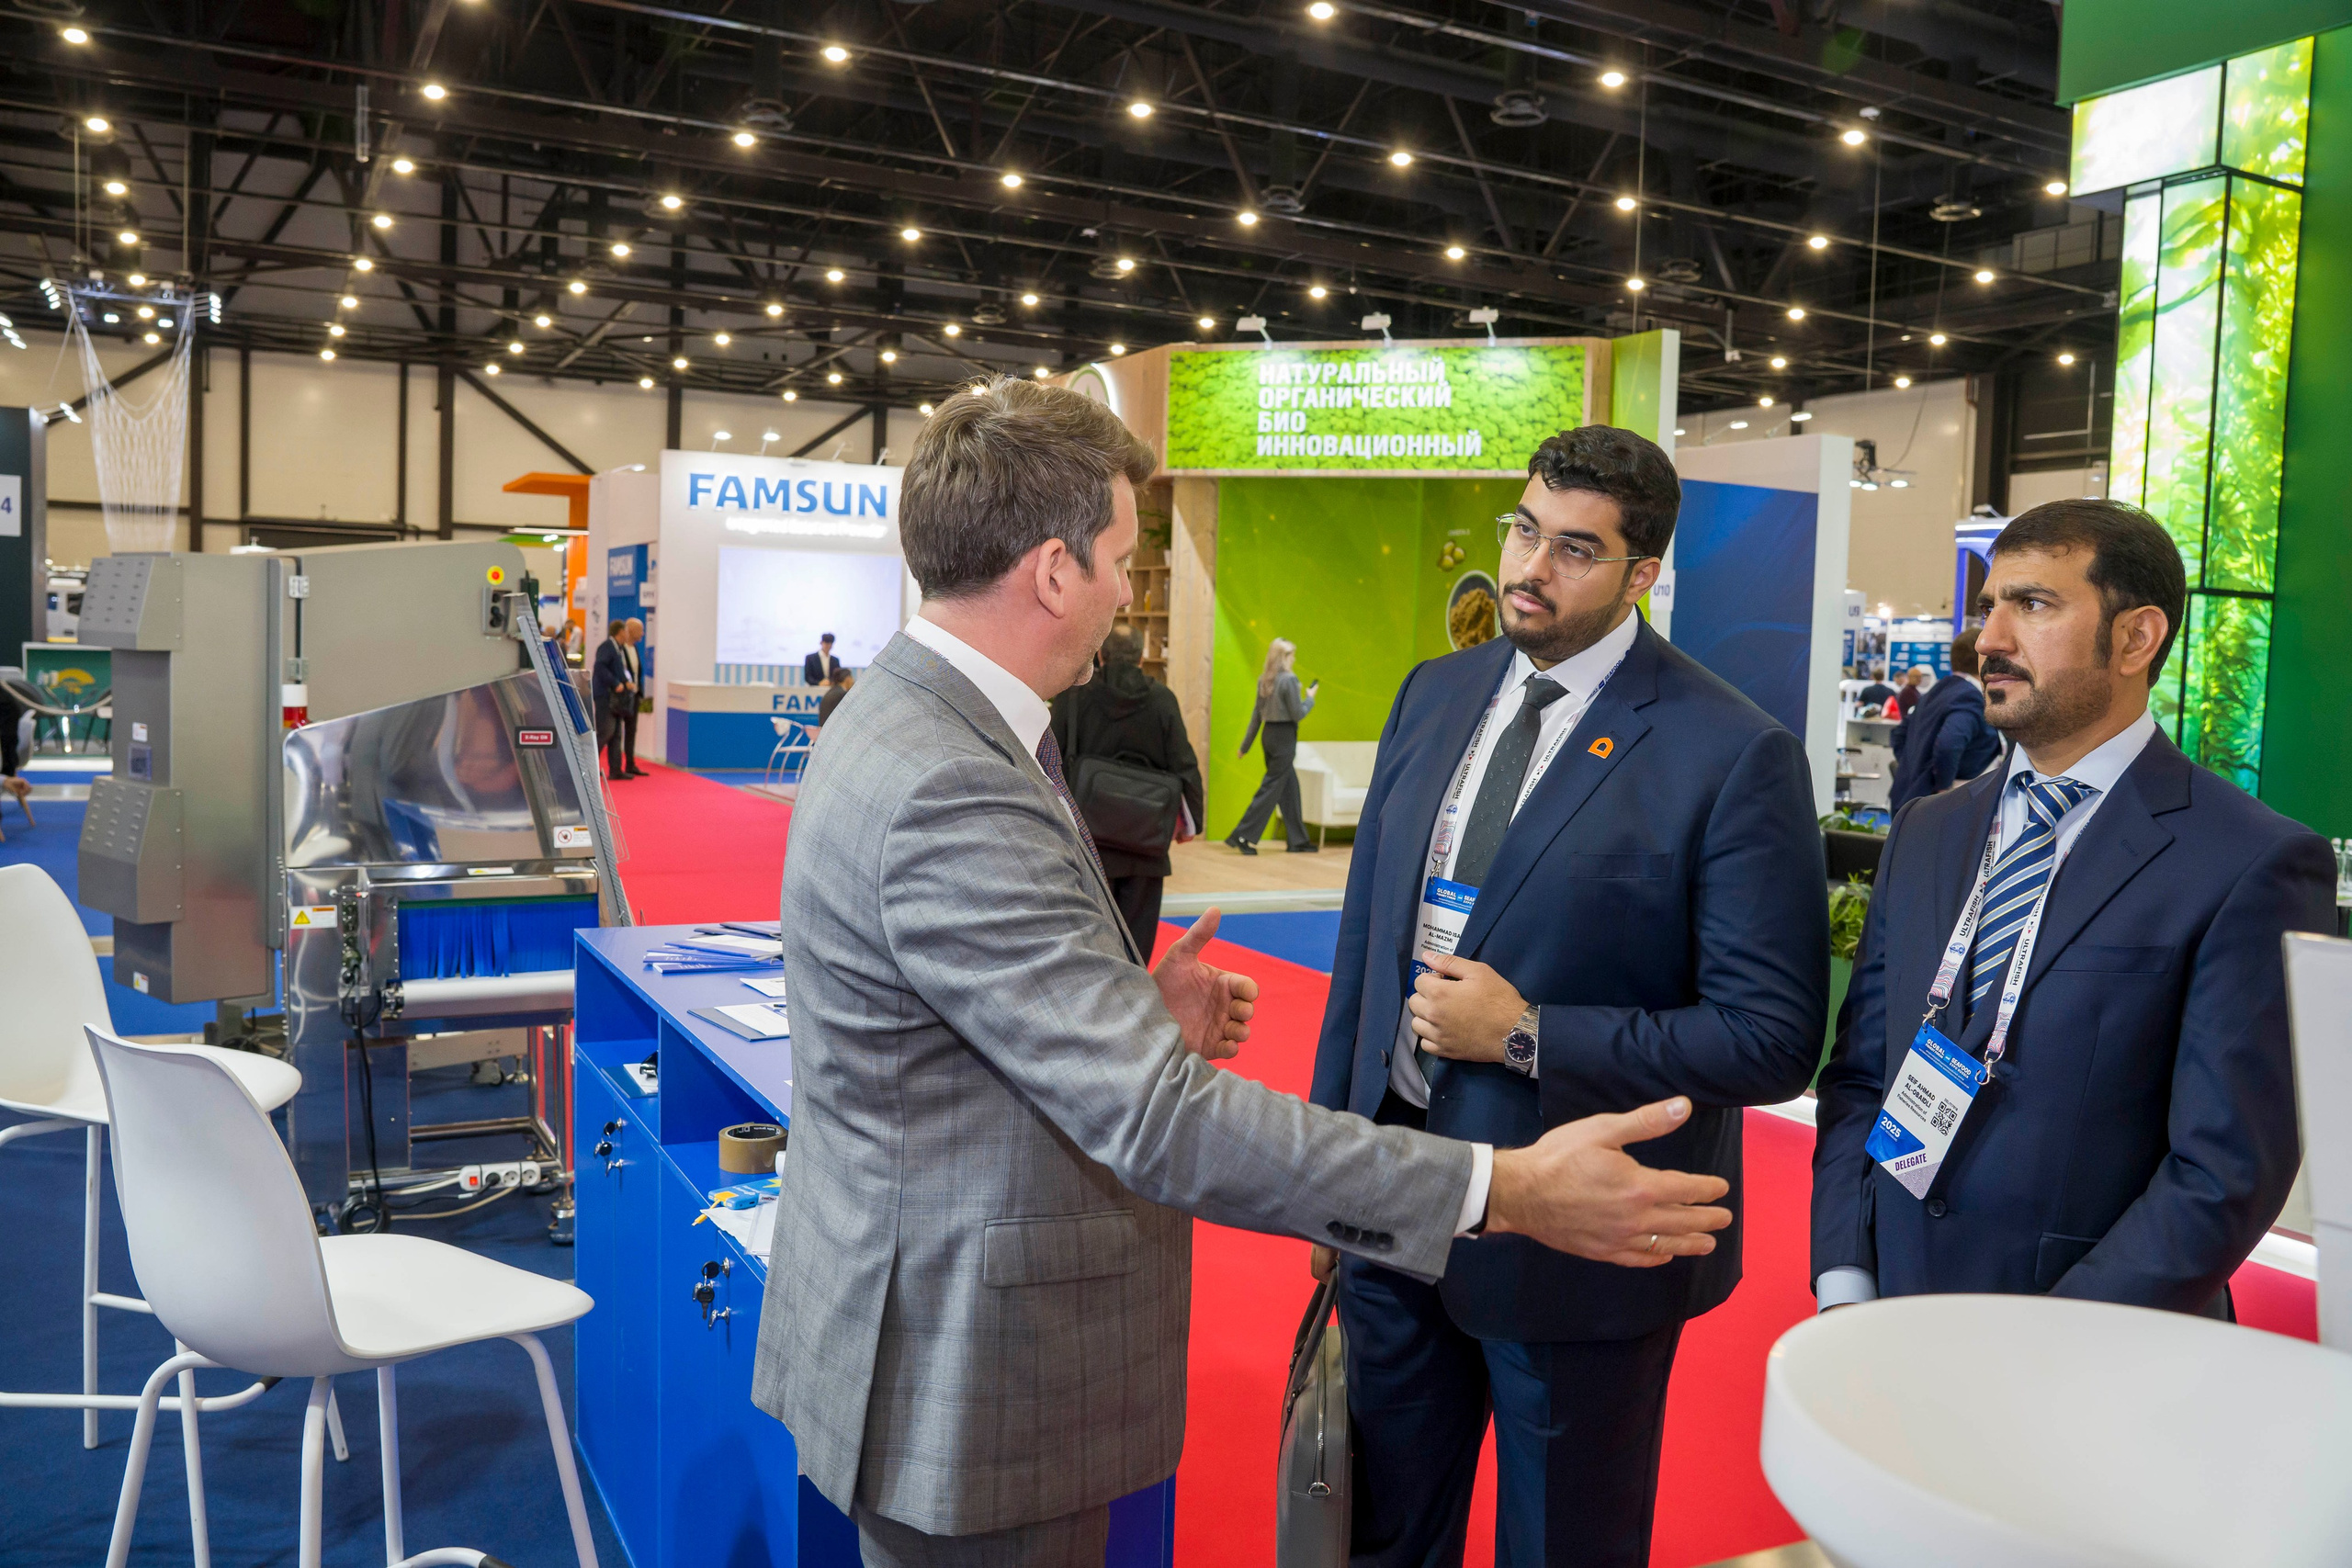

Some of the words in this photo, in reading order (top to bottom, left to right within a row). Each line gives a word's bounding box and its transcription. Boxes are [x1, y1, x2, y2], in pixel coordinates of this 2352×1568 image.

[1258, 356, 1446, 385] НАТУРАЛЬНЫЙ
[1258, 380, 1452, 409] ОРГАНИЧЕСКИЙ
[1257, 410, 1306, 433] БИО
[1256, 430, 1482, 459] ИННОВАЦИОННЫЙ
[689, 472, 887, 518] FAMSUN
[1654, 584, 1670, 596] U10
[772, 694, 823, 711] FAM
[1474, 713, 1489, 748] ULTRAFISH
[1544, 728, 1567, 762] ULTRAFISH
[1454, 763, 1471, 799] ULTRAFISH
[1984, 840, 1993, 878] ULTRAFISH
[1436, 887, 1456, 898] GLOBAL
[1464, 895, 1476, 903] SEAF
[1422, 922, 1453, 936] MOHAMMAD
[1960, 895, 1980, 937] ULTRAFISH
[1428, 932, 1453, 943] AL-MAZMI
[2013, 938, 2030, 987] ULTRAFISH
[1927, 1038, 1945, 1056] GLOBAL
[1951, 1057, 1972, 1076] SEAFOOD
[1905, 1082, 1932, 1109] AL-OBAIDLI
[1907, 1074, 1919, 1085] SEIF
[1917, 1083, 1936, 1101] AHMAD
[1901, 1090, 1924, 1113] Administration
[1910, 1105, 1927, 1122] Resources
[1881, 1116, 1902, 1138] 2025
[1894, 1153, 1928, 1172] DELEGATE
